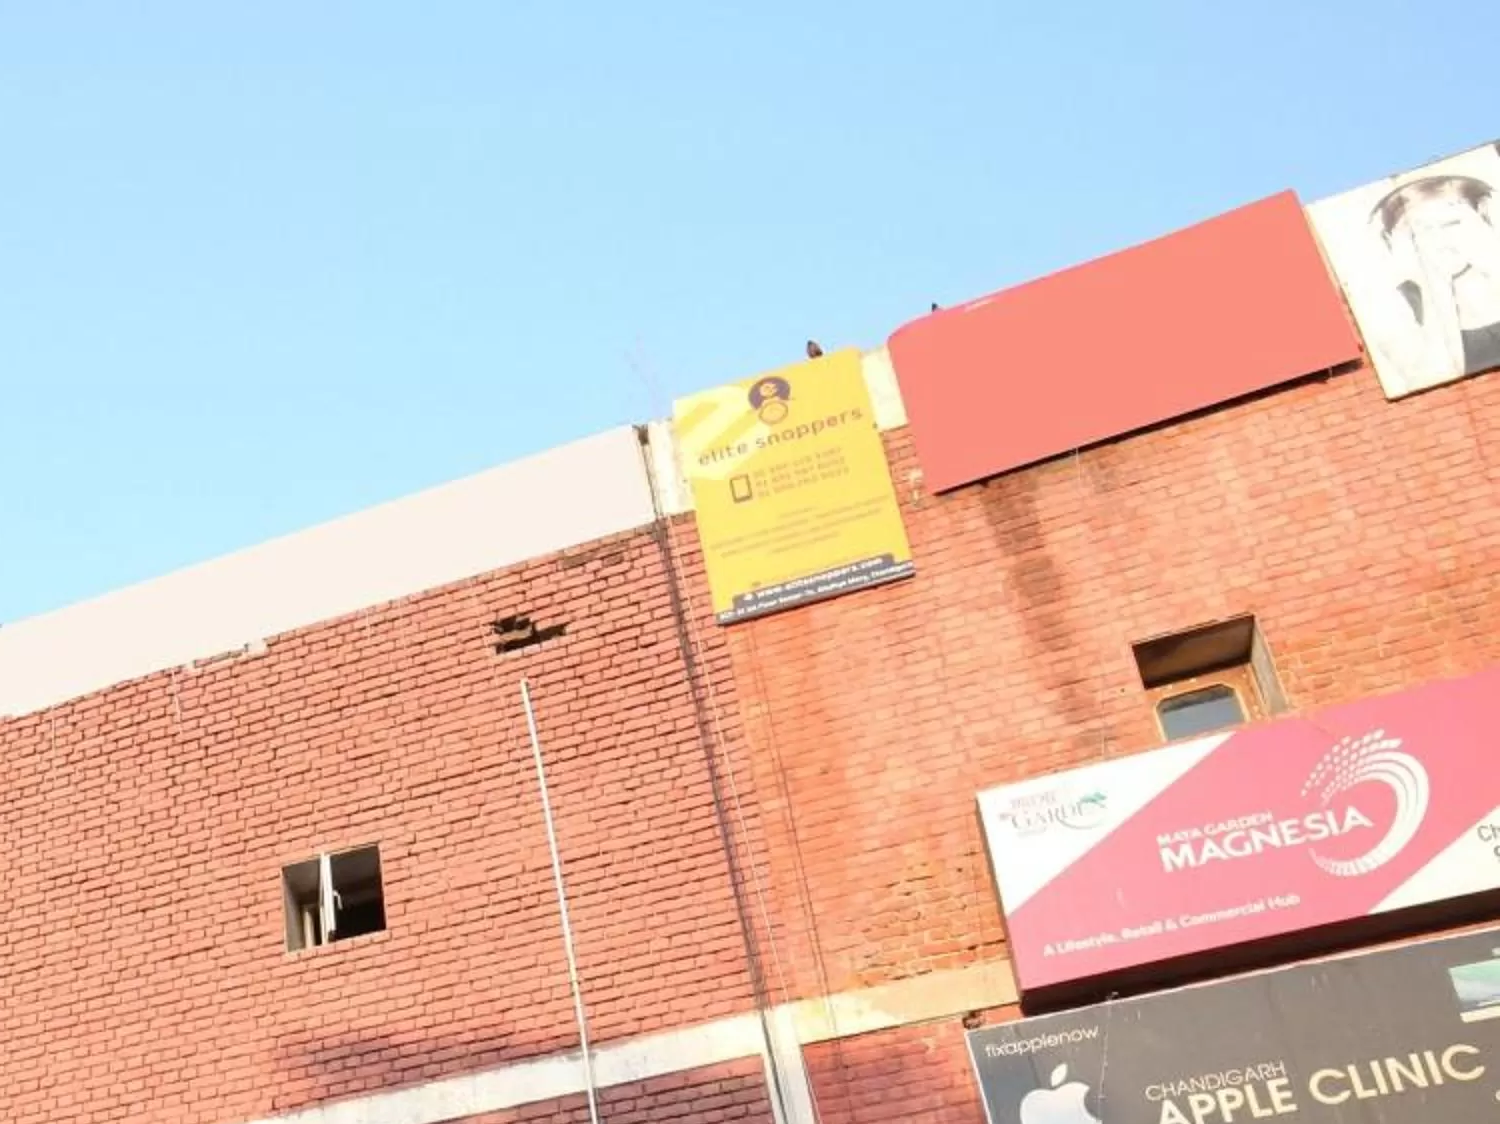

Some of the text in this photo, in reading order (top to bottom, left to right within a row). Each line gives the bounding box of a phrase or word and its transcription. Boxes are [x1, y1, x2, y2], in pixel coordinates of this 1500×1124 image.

[1159, 805, 1375, 873] MAGNESIA
[985, 1025, 1099, 1057] fixapplenow
[1144, 1059, 1286, 1102] CHANDIGARH
[1309, 1044, 1485, 1105] CLINIC
